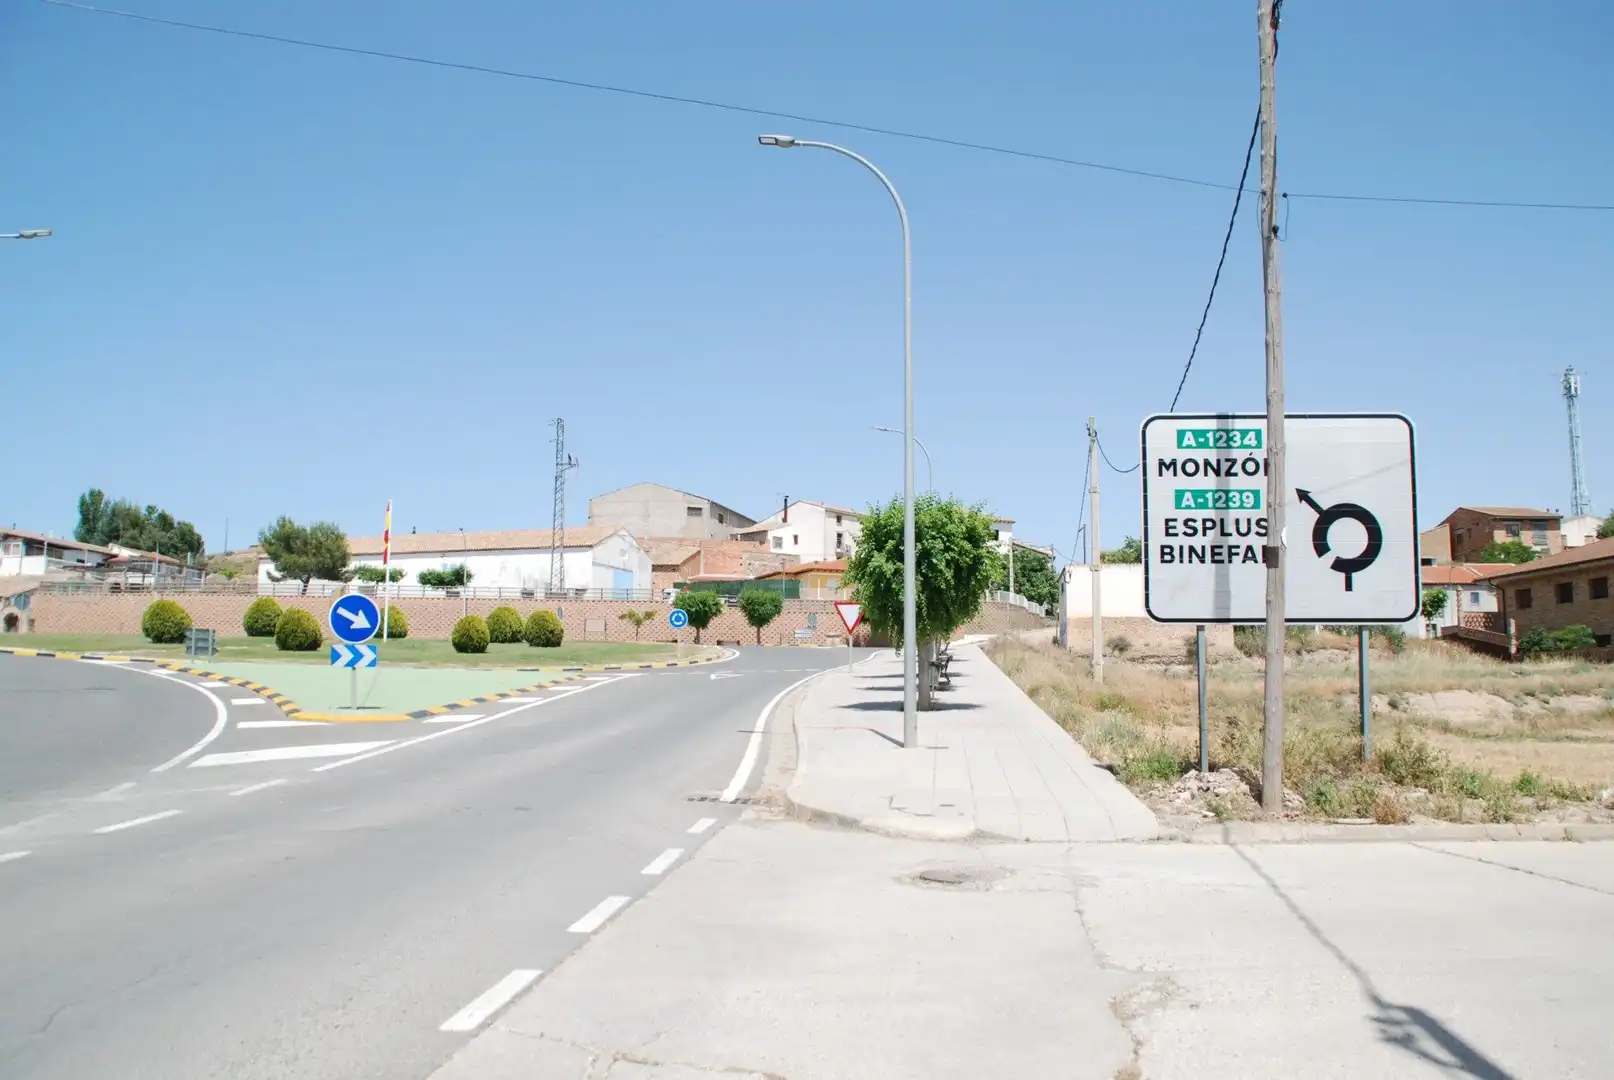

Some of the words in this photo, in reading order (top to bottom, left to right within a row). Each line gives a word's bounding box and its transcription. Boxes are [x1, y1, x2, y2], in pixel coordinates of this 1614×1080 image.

[1182, 430, 1257, 447] A-1234
[1158, 452, 1268, 477] MONZÓ
[1180, 491, 1255, 508] A-1239
[1164, 517, 1268, 537] ESPLUS
[1160, 544, 1267, 564] BINEFA
